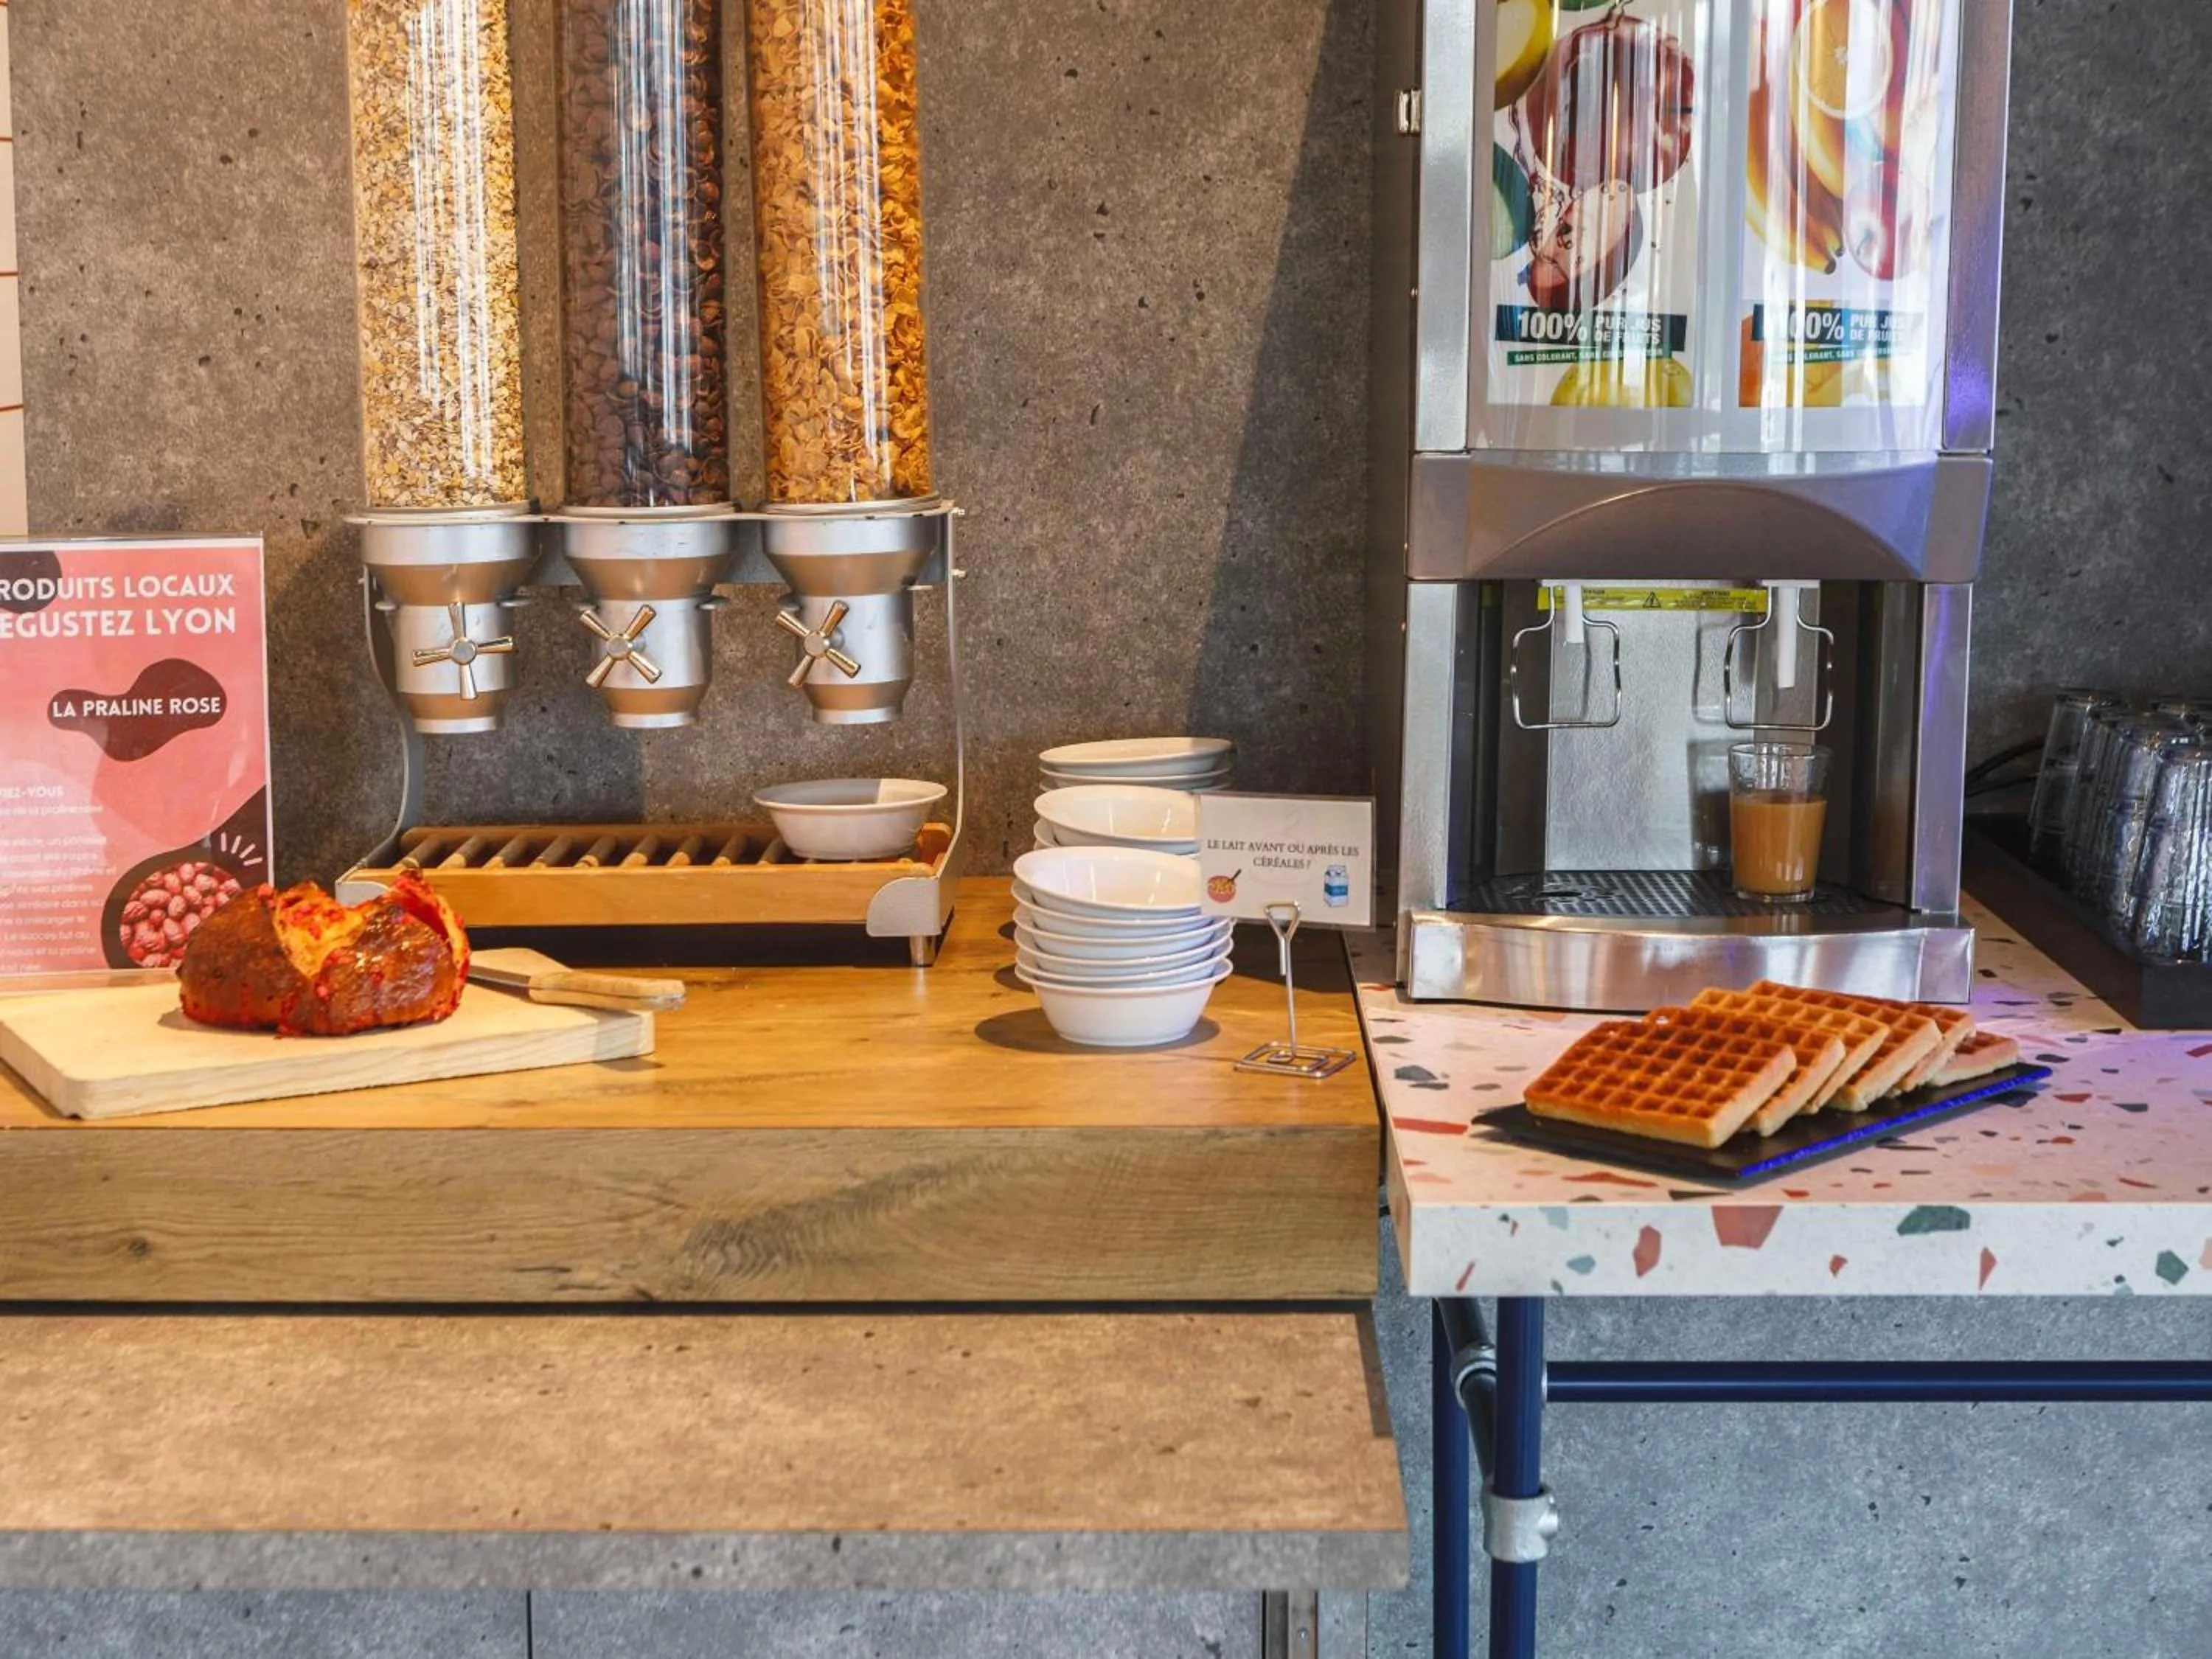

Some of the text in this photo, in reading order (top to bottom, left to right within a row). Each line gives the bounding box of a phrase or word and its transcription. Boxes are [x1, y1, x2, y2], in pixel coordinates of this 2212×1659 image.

[1518, 310, 1587, 342] 100%
[1595, 314, 1625, 330] PUR
[1850, 313, 1878, 330] PUR
[1594, 330, 1611, 343] DE
[1850, 329, 1865, 341] DE
[1514, 352, 1534, 362] SANS
[124, 574, 235, 599] LOCAUX
[146, 607, 235, 636] LYON
[52, 697, 220, 717] LA PRALINE ROSE
[1207, 840, 1360, 856] LE LAIT AVANT OU APRÈS LES
[1253, 855, 1305, 868] CÉRÉALES
